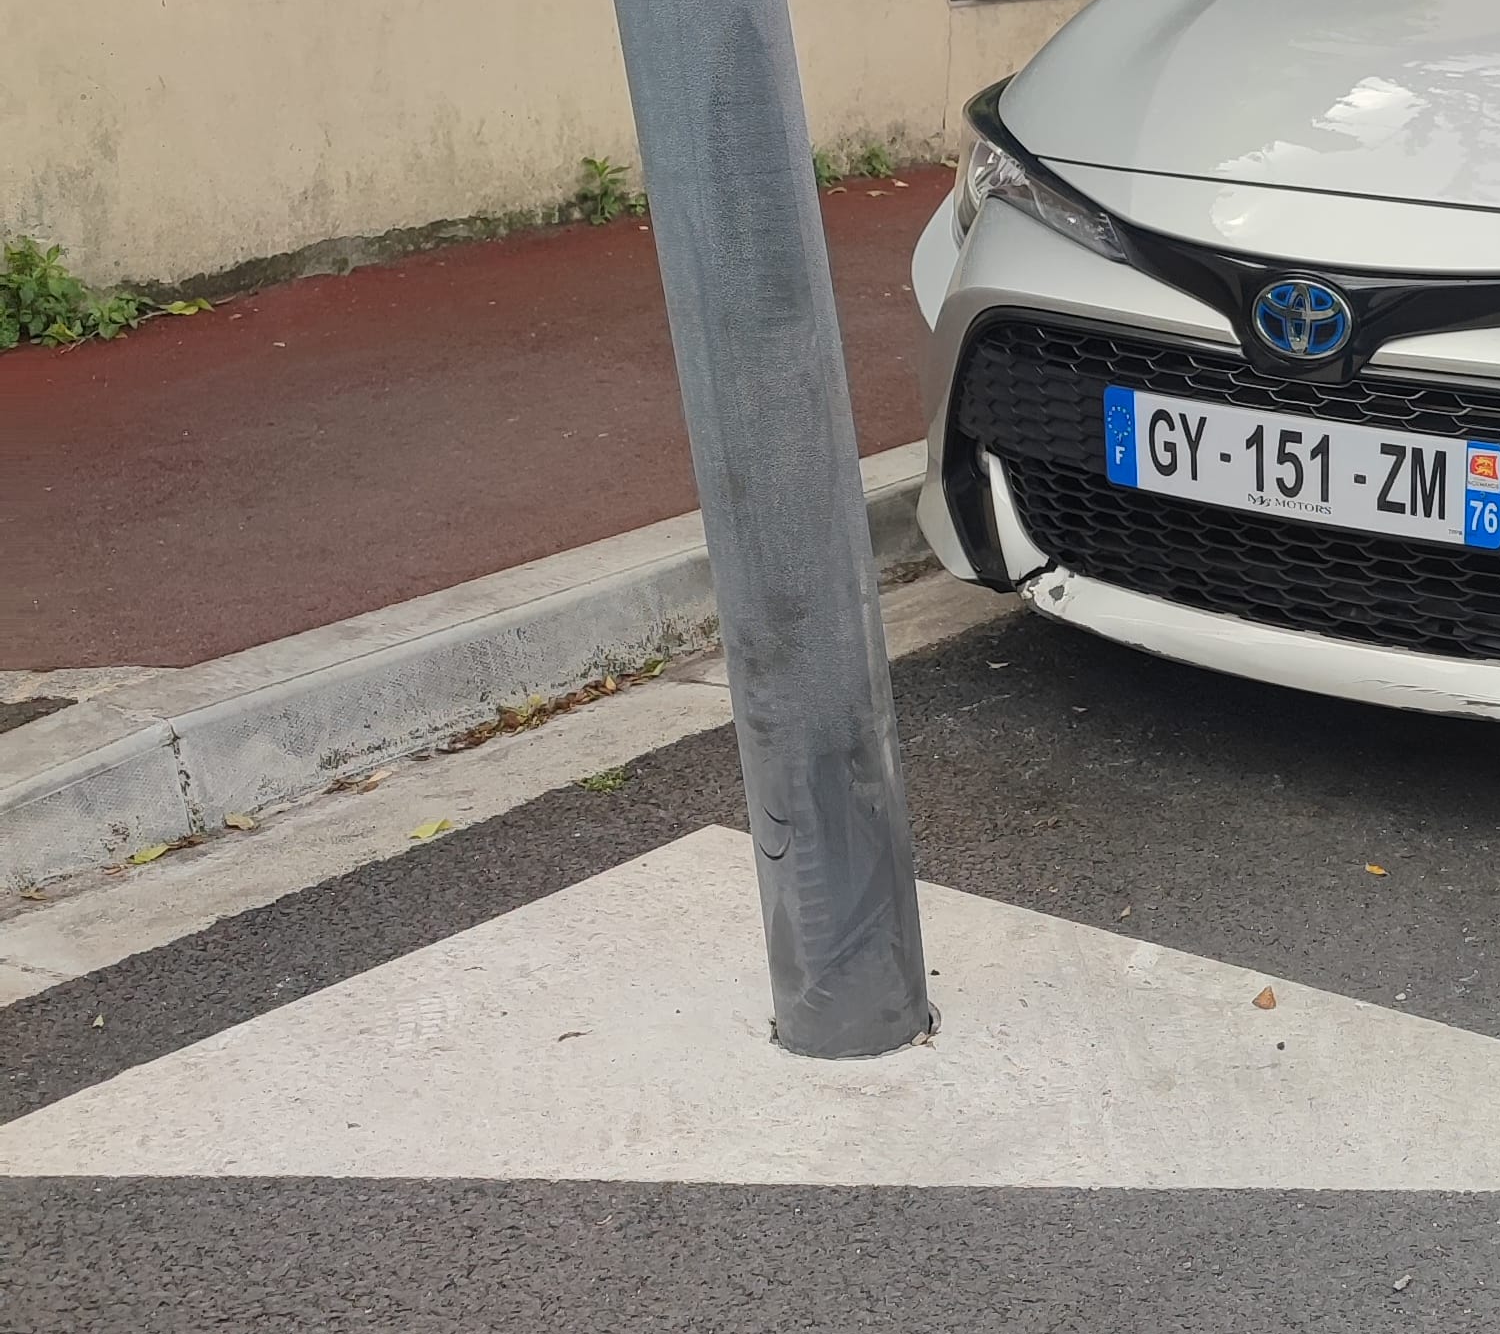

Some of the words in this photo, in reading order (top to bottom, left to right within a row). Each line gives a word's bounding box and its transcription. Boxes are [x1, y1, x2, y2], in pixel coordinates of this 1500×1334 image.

[1115, 446, 1126, 464] F
[1149, 409, 1447, 520] GY-151-ZM
[1275, 498, 1332, 515] MOTORS
[1469, 500, 1498, 534] 76
